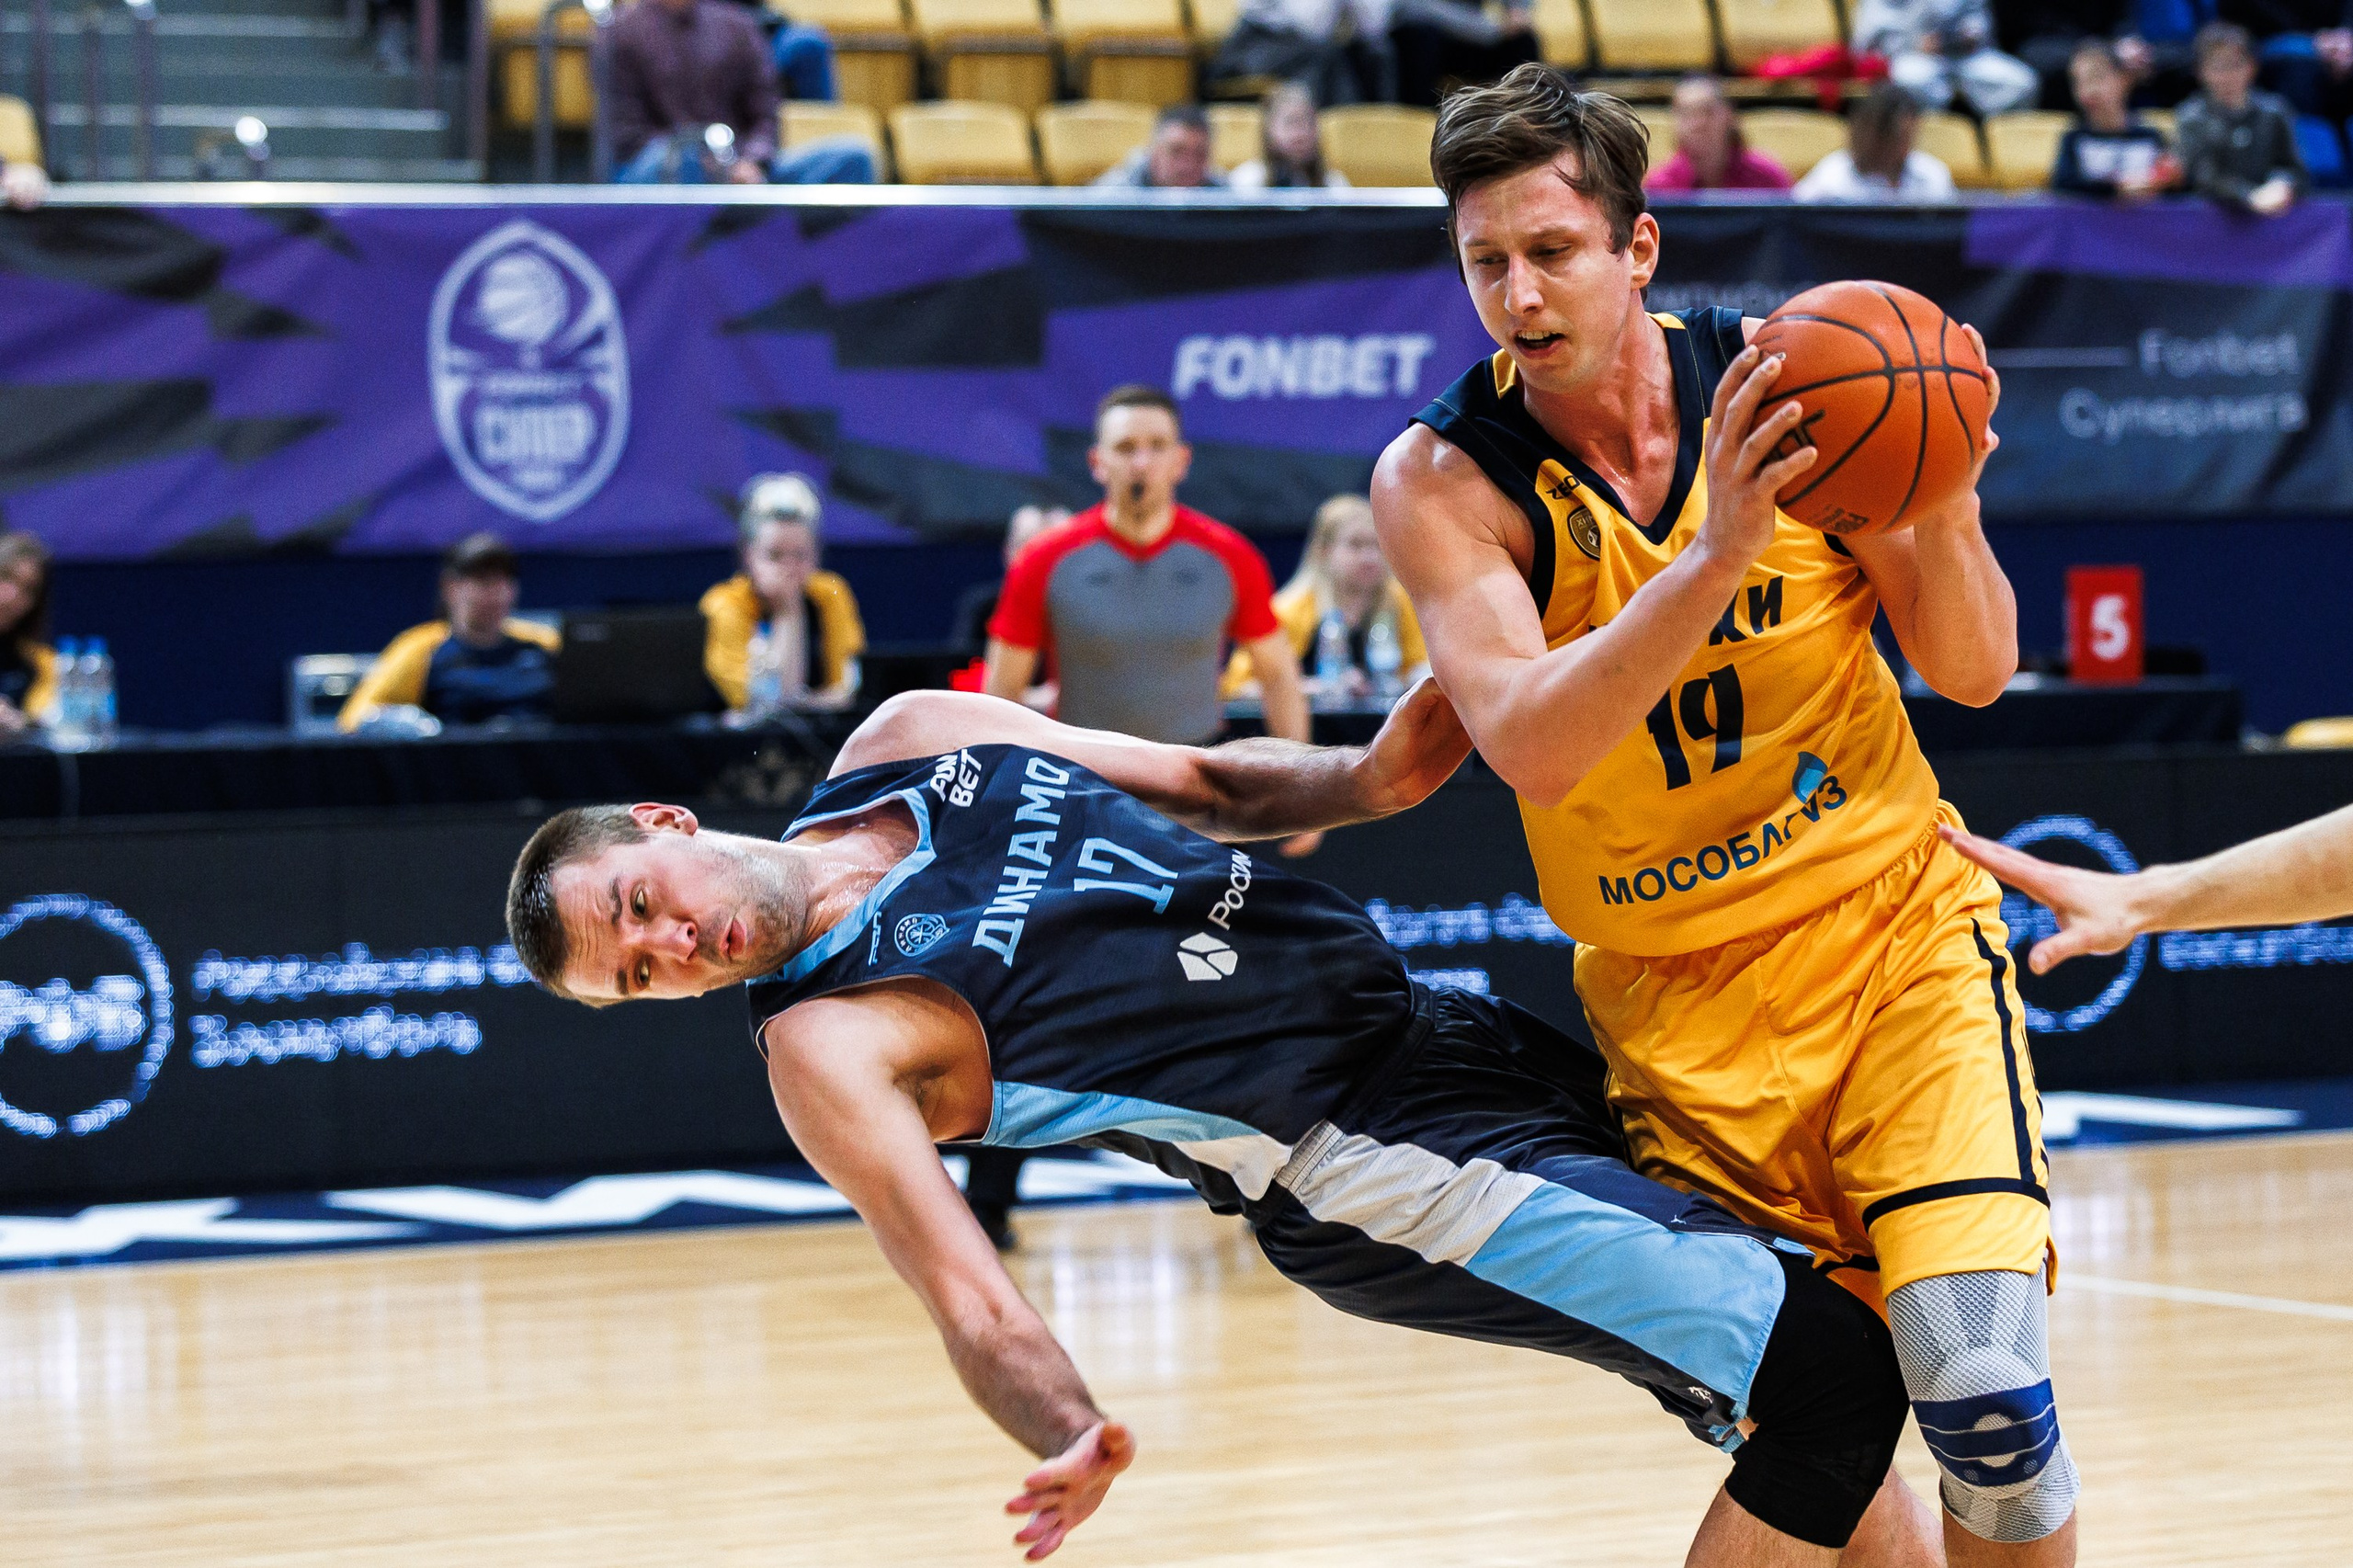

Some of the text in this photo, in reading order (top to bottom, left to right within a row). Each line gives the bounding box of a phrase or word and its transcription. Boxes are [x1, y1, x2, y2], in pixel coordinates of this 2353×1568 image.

[1174, 334, 1435, 399] FONBET
[2090, 595, 2130, 660] 5
[1645, 663, 1745, 791] 19
[949, 748, 983, 808] BET
[972, 756, 1071, 969] ДИНАМО
[1073, 836, 1179, 915] 17
